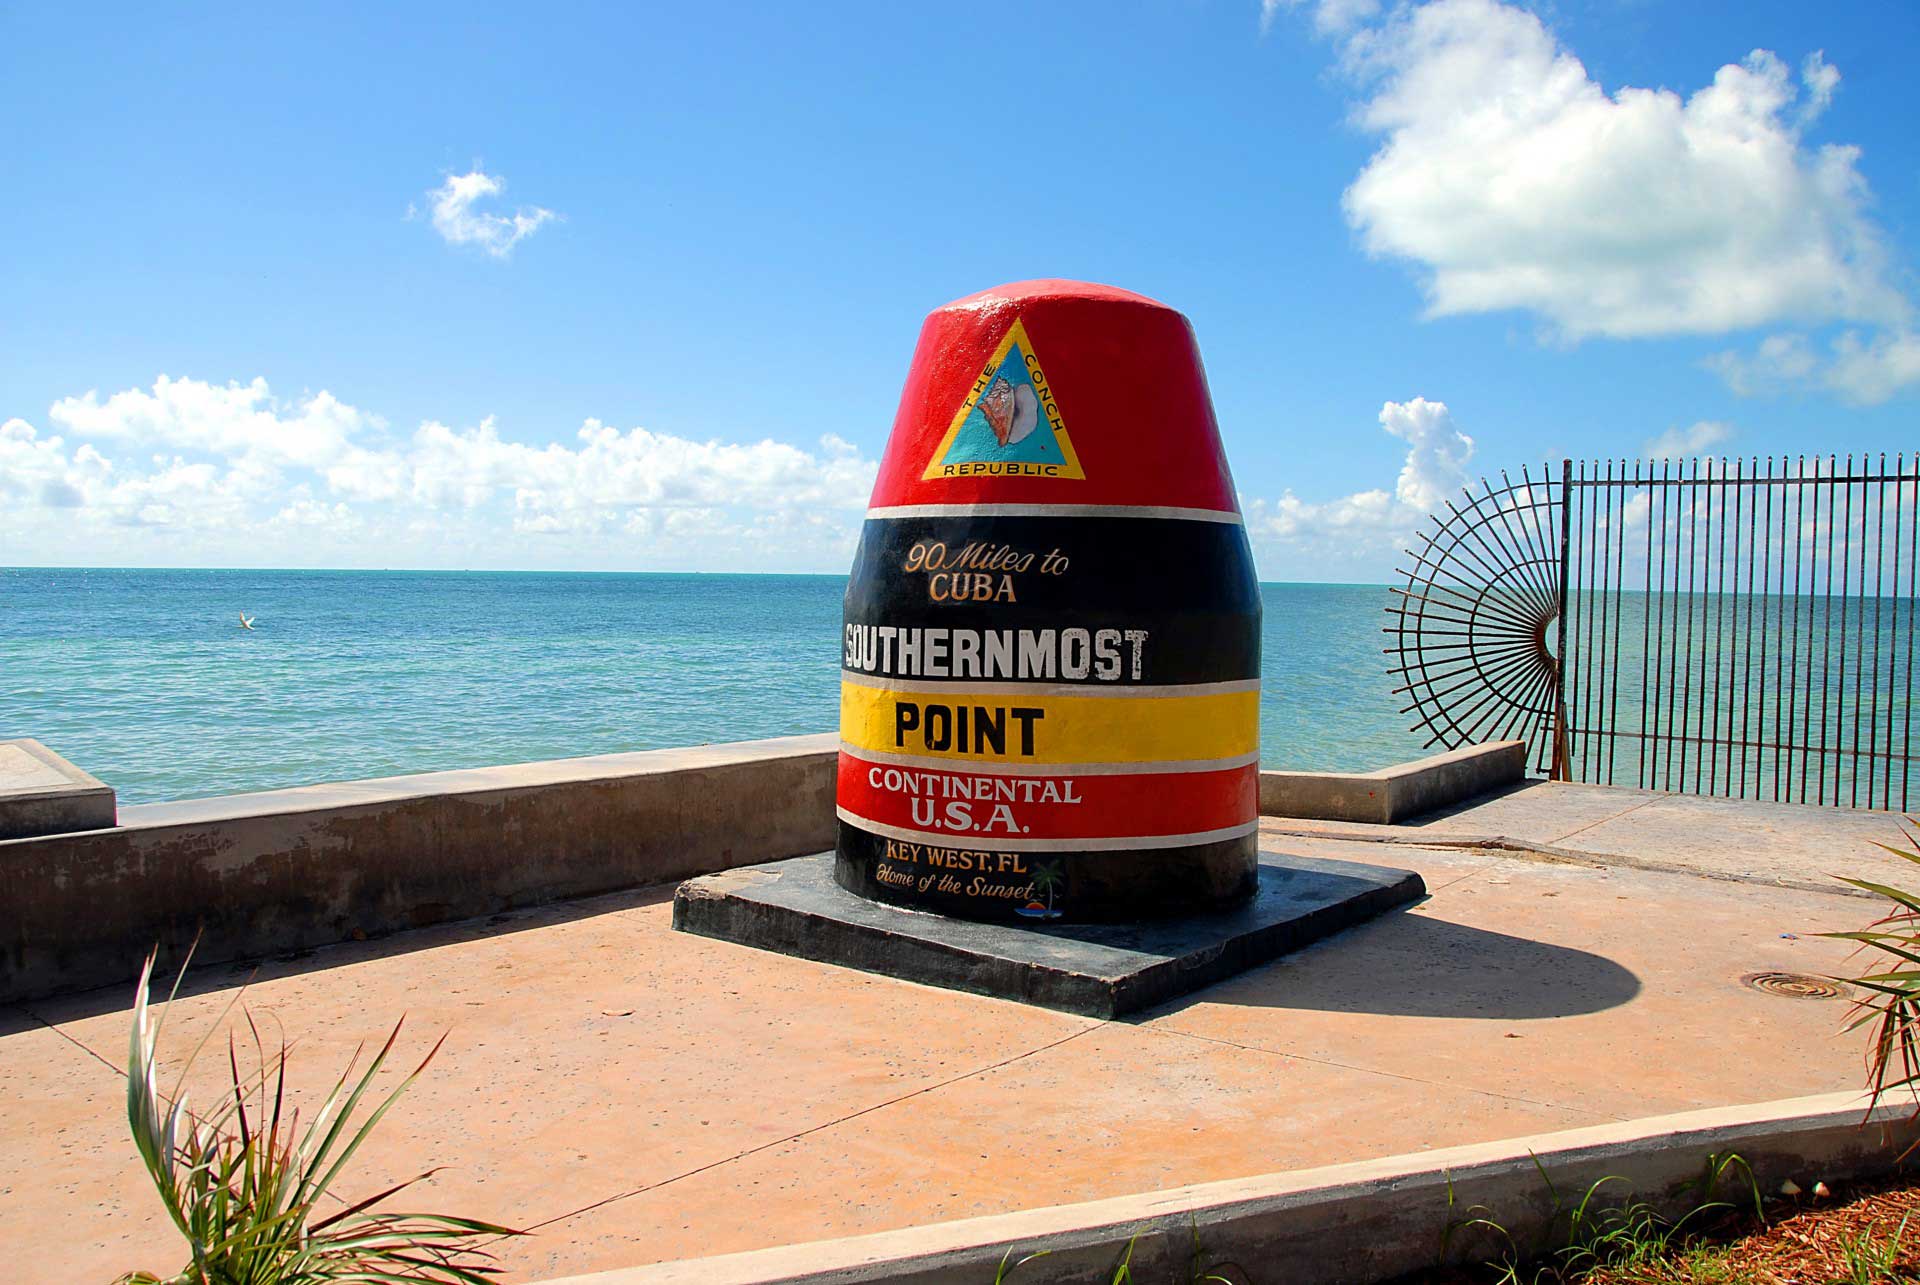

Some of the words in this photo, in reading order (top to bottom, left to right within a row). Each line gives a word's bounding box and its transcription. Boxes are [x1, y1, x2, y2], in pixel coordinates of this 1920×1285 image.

[962, 363, 996, 409] THE
[1025, 354, 1063, 431] CONCH
[944, 463, 1058, 476] REPUBLIC
[904, 541, 945, 573] 90
[944, 541, 1035, 573] Miles
[1040, 547, 1069, 576] to
[929, 572, 1017, 602] CUBA
[845, 623, 1149, 681] SOUTHERNMOST
[895, 701, 1045, 756] POINT
[868, 767, 1082, 804] CONTINENTAL
[911, 797, 1030, 833] U.S.A.
[886, 840, 922, 863] KEY
[926, 846, 993, 873] WEST,
[998, 853, 1028, 873] FL
[876, 863, 914, 887] Home
[918, 874, 936, 893] of
[937, 873, 961, 894] the
[966, 877, 1036, 900] Sunset
